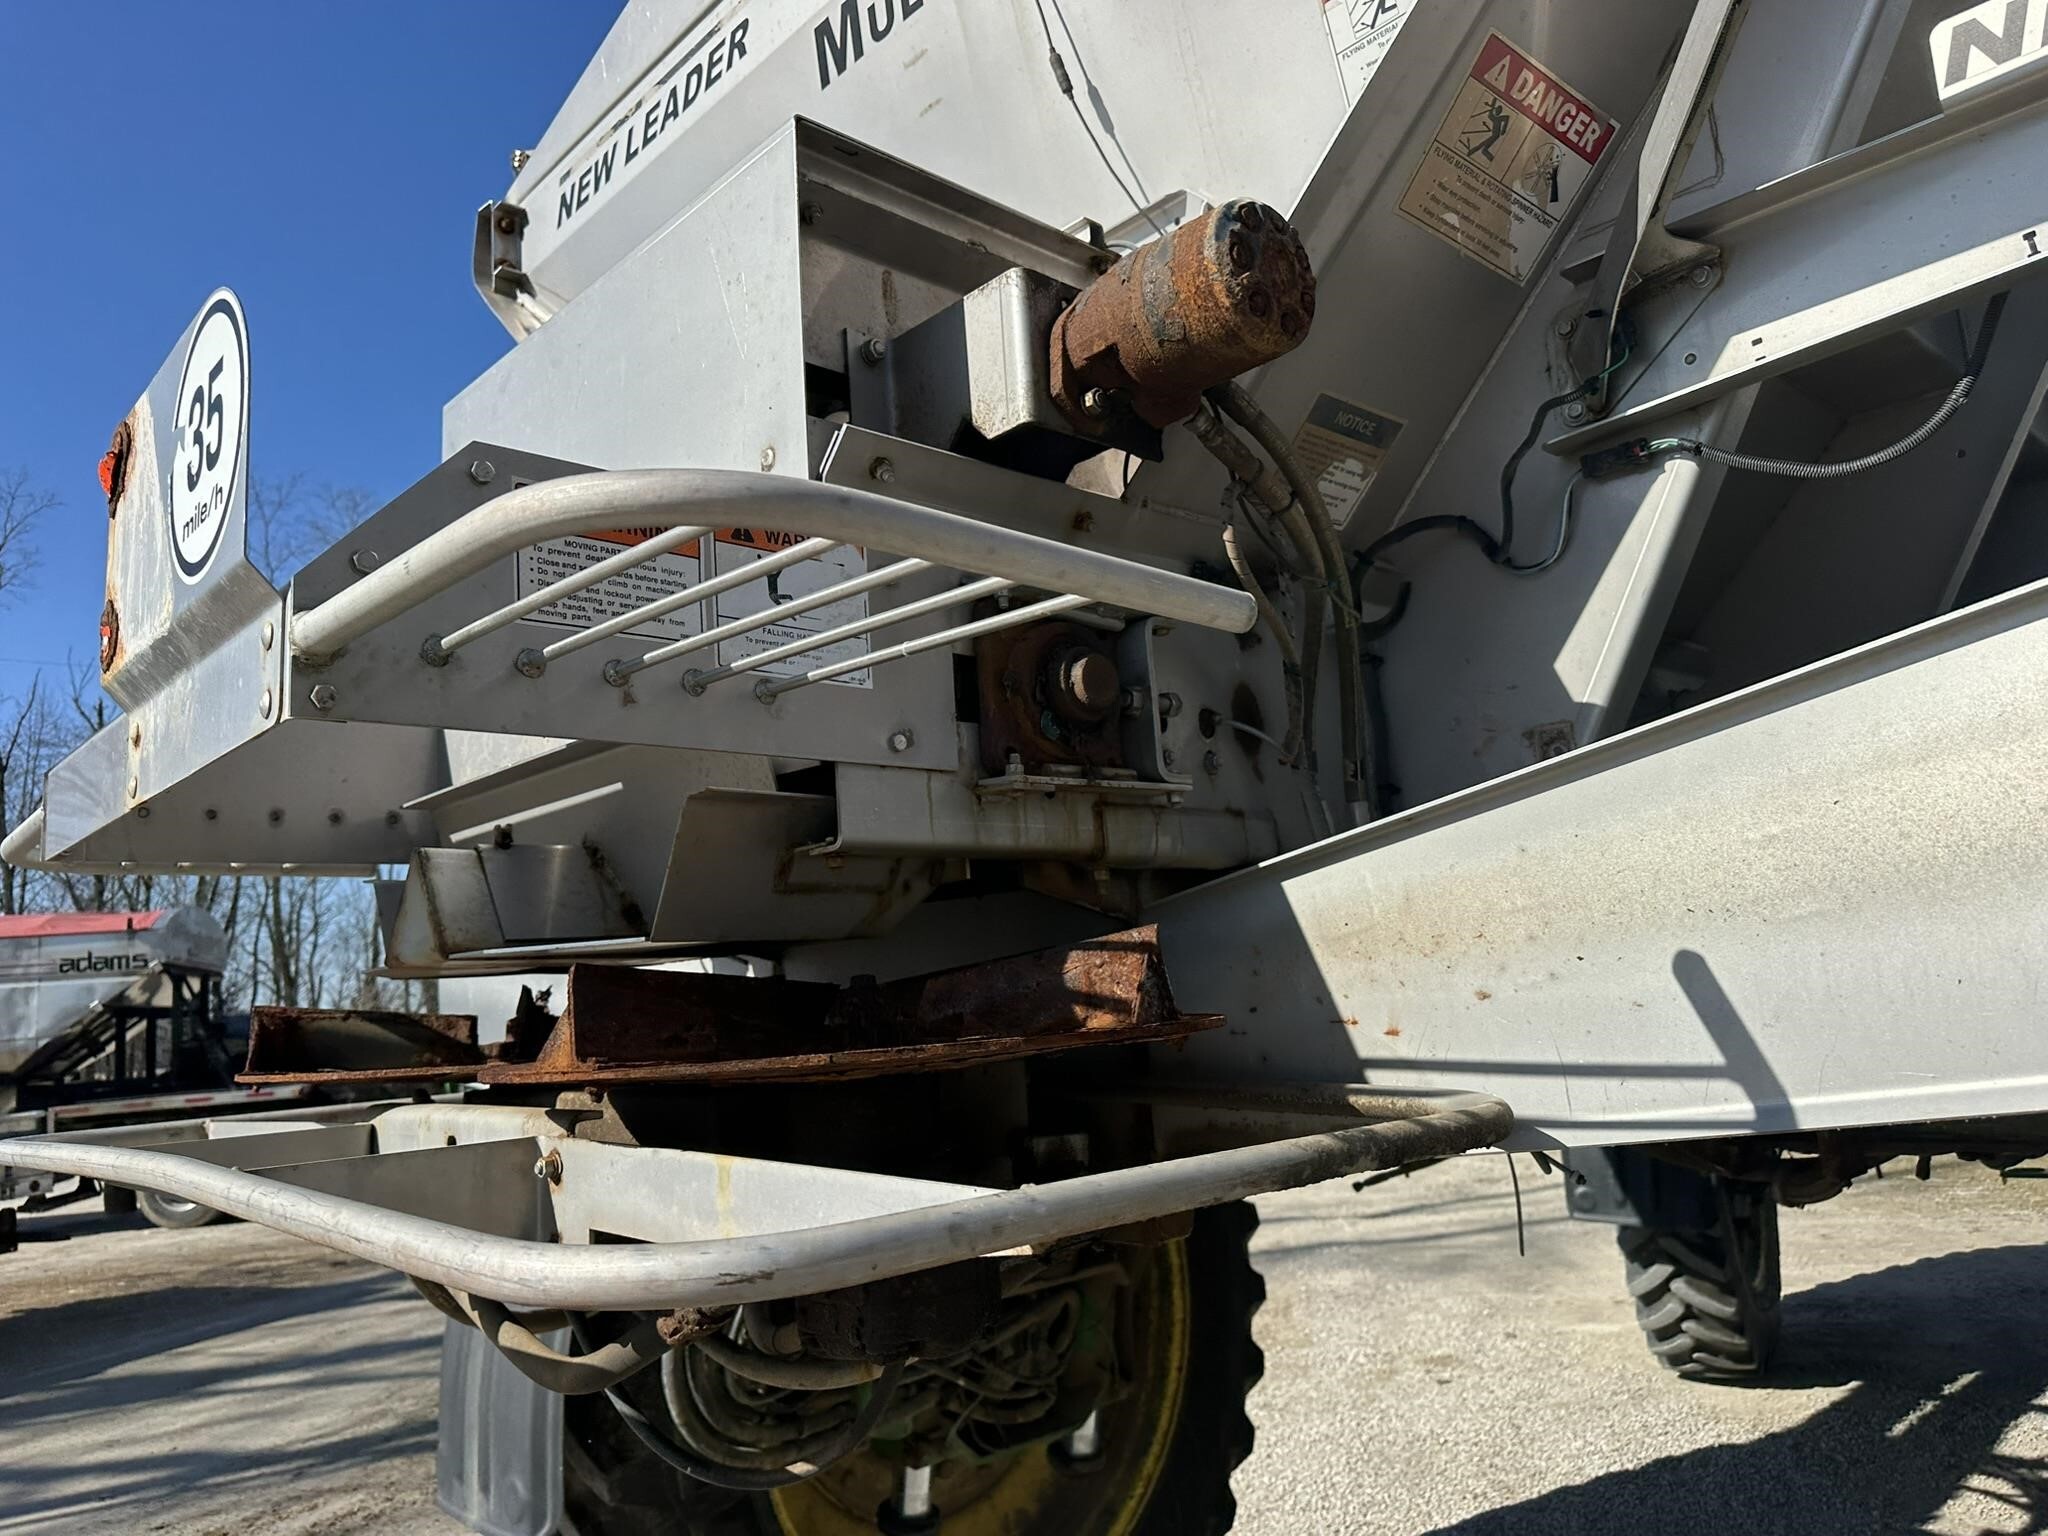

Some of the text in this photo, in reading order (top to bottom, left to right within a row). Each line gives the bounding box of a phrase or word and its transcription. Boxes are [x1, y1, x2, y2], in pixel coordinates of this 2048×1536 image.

[1342, 42, 1366, 61] FLYING
[1944, 0, 2048, 88] N
[1509, 67, 1601, 153] DANGER
[557, 17, 749, 230] NEW LEADER
[1433, 146, 1455, 165] FLYING
[1454, 158, 1480, 183] MATERIAL
[1511, 197, 1533, 215] SPINNER
[1532, 211, 1554, 229] HAZARD
[187, 355, 224, 493] 35
[1334, 411, 1377, 436] NOTICE
[182, 483, 224, 543] mile/h
[564, 539, 598, 553] MOVING
[537, 556, 560, 567] Close
[562, 562, 577, 570] and
[635, 573, 659, 584] before
[547, 547, 581, 559] prevent
[661, 566, 686, 578] injury:
[537, 567, 548, 576] Do
[553, 570, 566, 578] not
[608, 579, 628, 589] climb
[567, 594, 603, 606] adjusting
[586, 587, 600, 595] and
[604, 589, 631, 600] lockout
[538, 608, 567, 620] moving
[562, 602, 589, 613] hands,
[593, 607, 607, 615] feet
[669, 618, 686, 627] from
[754, 638, 779, 647] prevent
[762, 627, 795, 639] FALLING
[59, 951, 148, 973] adams
